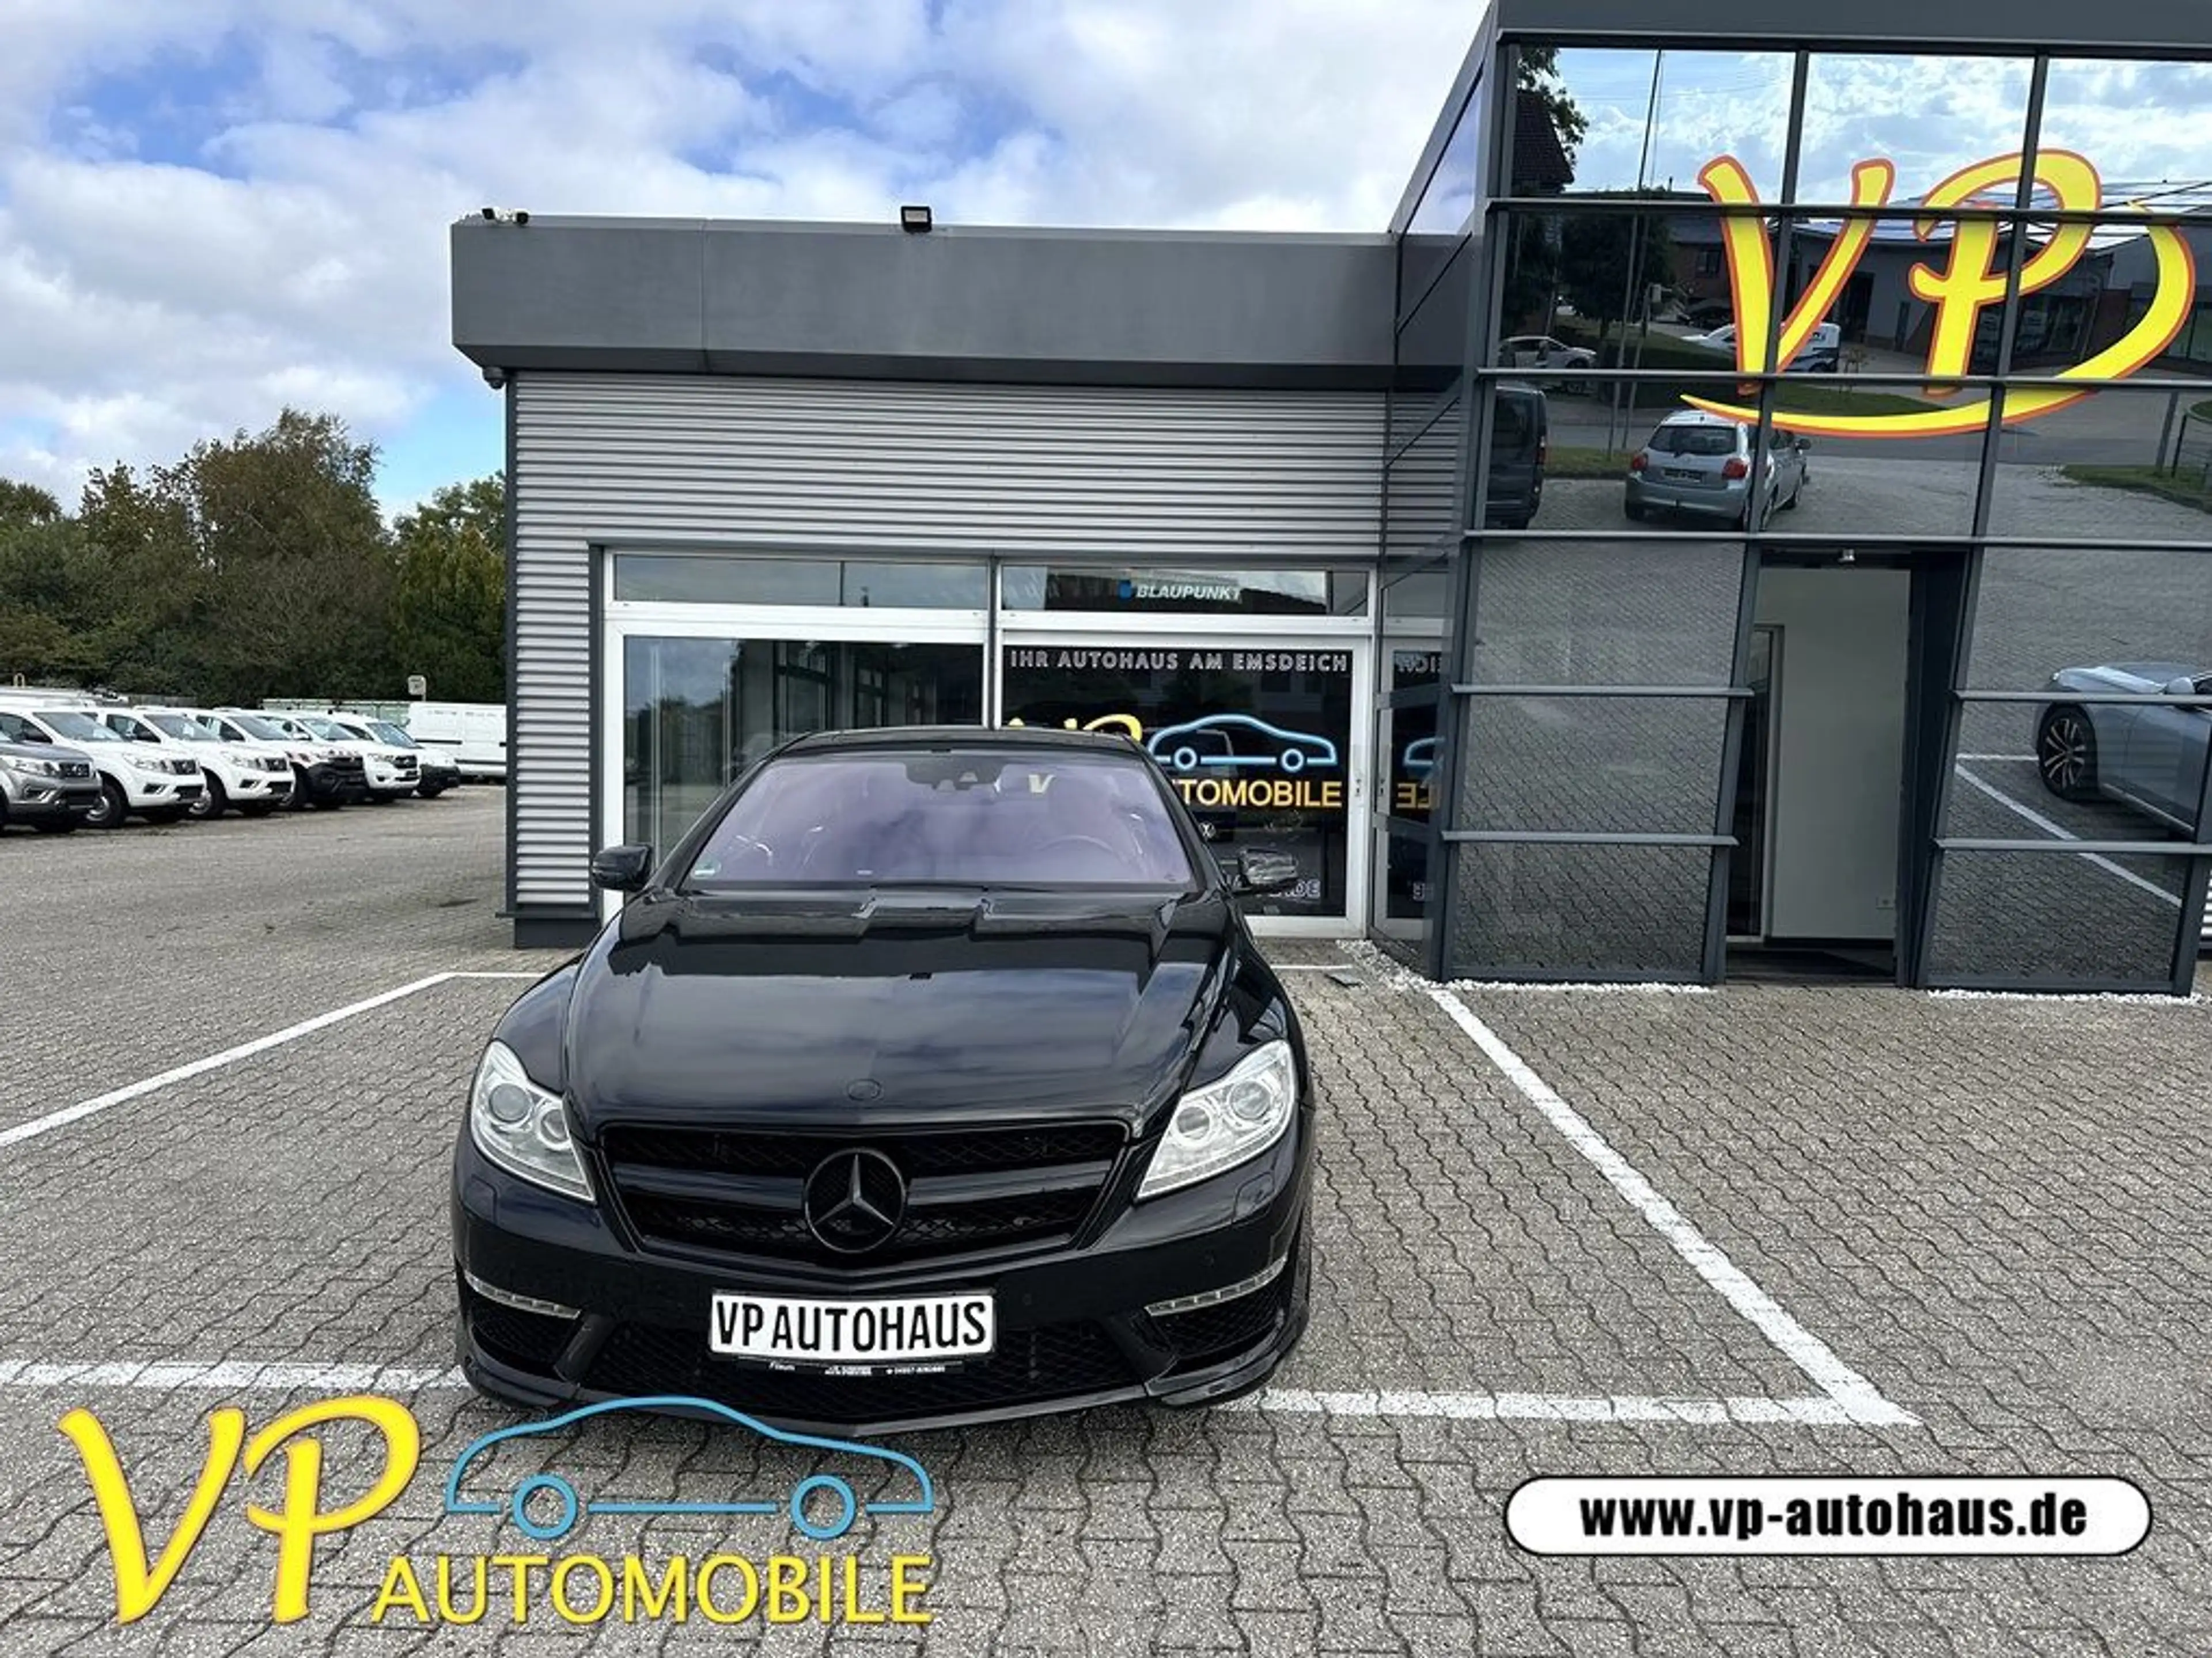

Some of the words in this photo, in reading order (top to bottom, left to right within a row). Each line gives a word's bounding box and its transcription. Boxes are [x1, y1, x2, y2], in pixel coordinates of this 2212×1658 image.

[1697, 148, 2101, 397] VP
[1137, 582, 1243, 602] BLAUPUNKT
[1010, 649, 1048, 668] IHR
[1057, 650, 1178, 670] AUTOHAUS
[1189, 652, 1222, 670] AM
[1232, 652, 1347, 672] EMSDEICH
[1173, 779, 1342, 806] TOMOBILE
[716, 1300, 764, 1346] VP
[771, 1301, 987, 1352] AUTOHAUS
